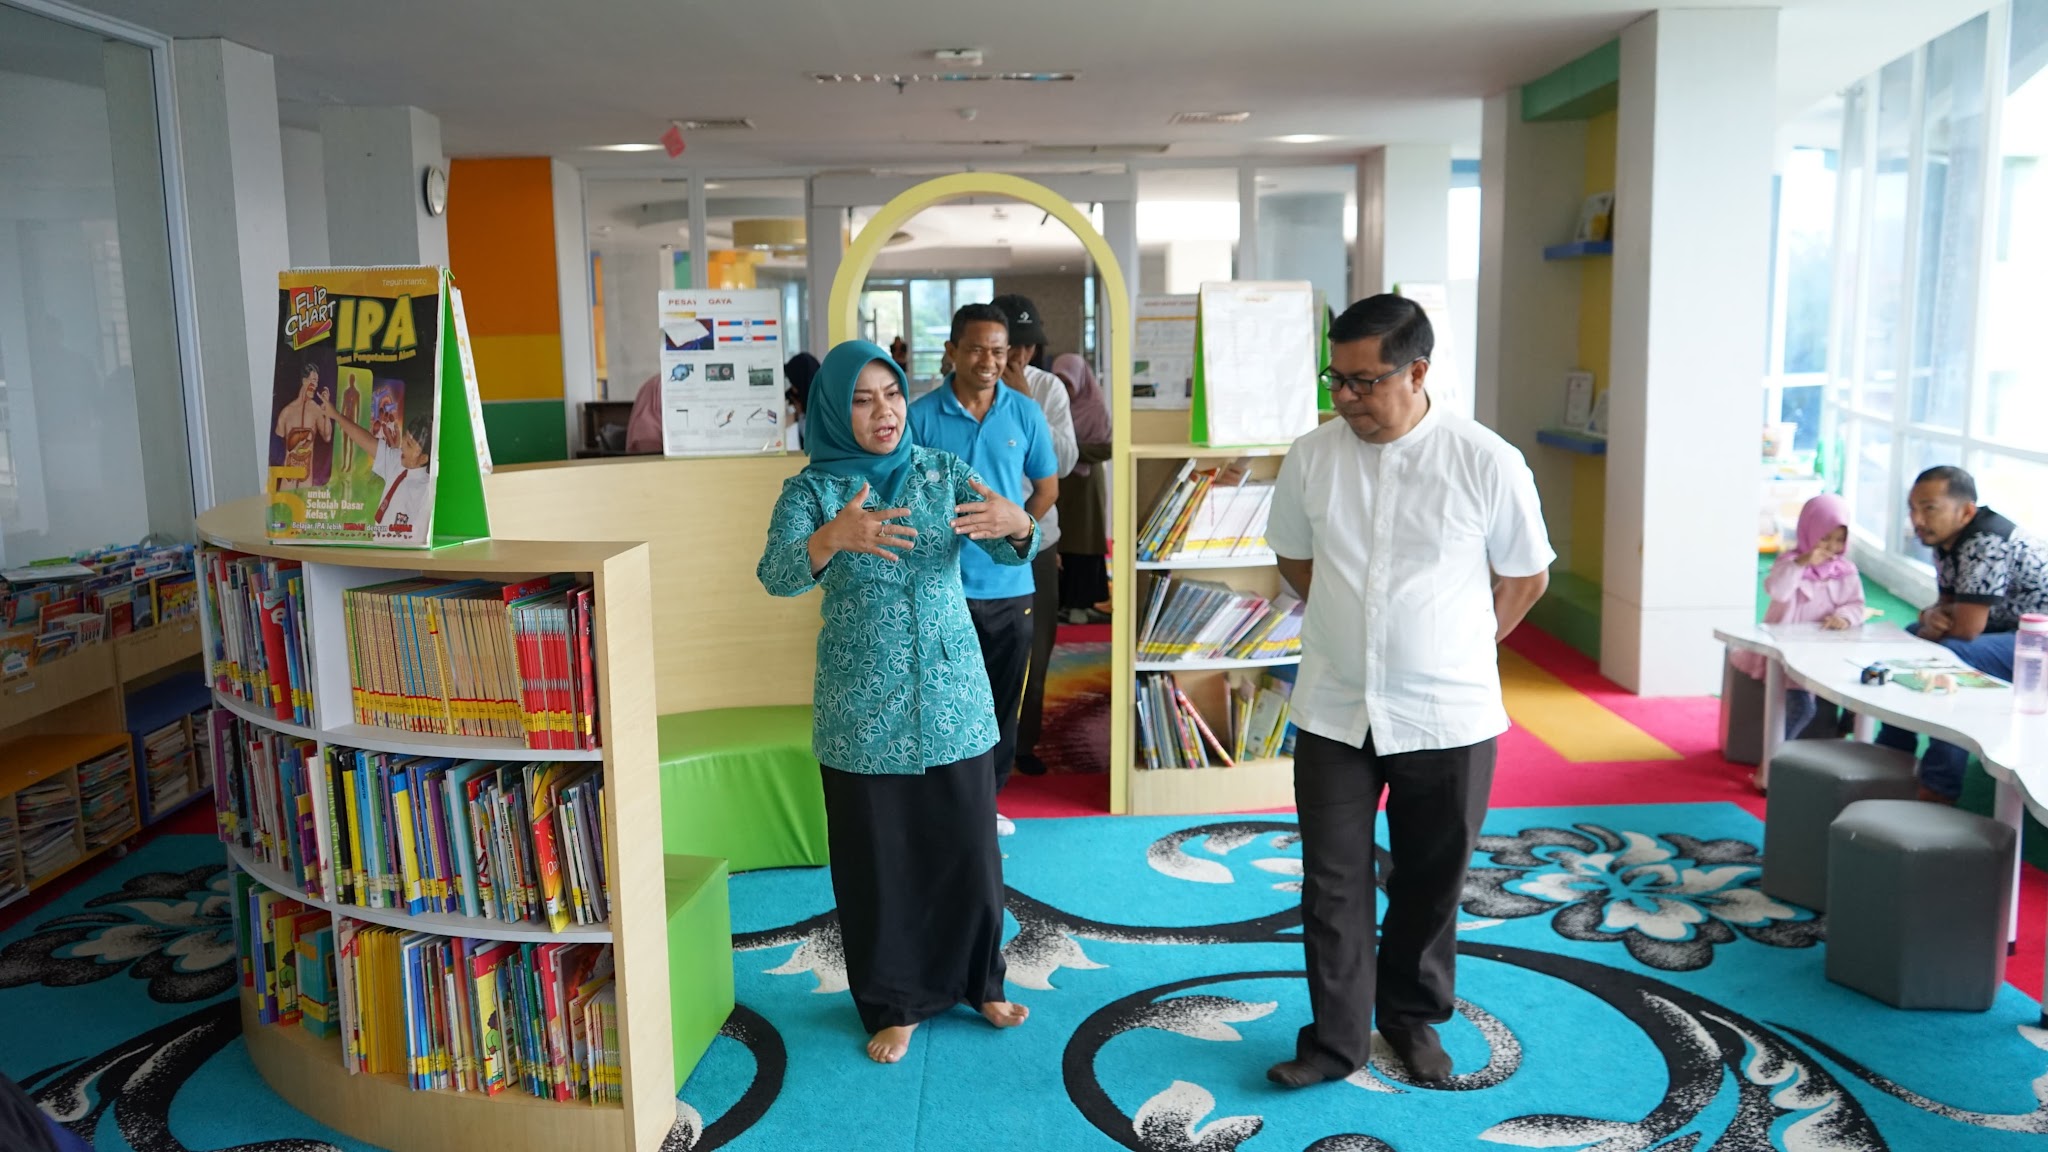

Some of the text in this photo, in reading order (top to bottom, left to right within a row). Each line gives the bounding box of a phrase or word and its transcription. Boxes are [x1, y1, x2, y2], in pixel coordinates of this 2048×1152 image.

[284, 300, 336, 336] CHART
[336, 293, 417, 353] IPA
[307, 489, 331, 499] untuk
[306, 500, 364, 511] Sekolah Dasar
[305, 509, 336, 520] Kelas V
[292, 522, 313, 531] Belajar
[314, 523, 325, 531] IPA
[326, 522, 342, 531] lebih
[366, 523, 388, 532] dengan
